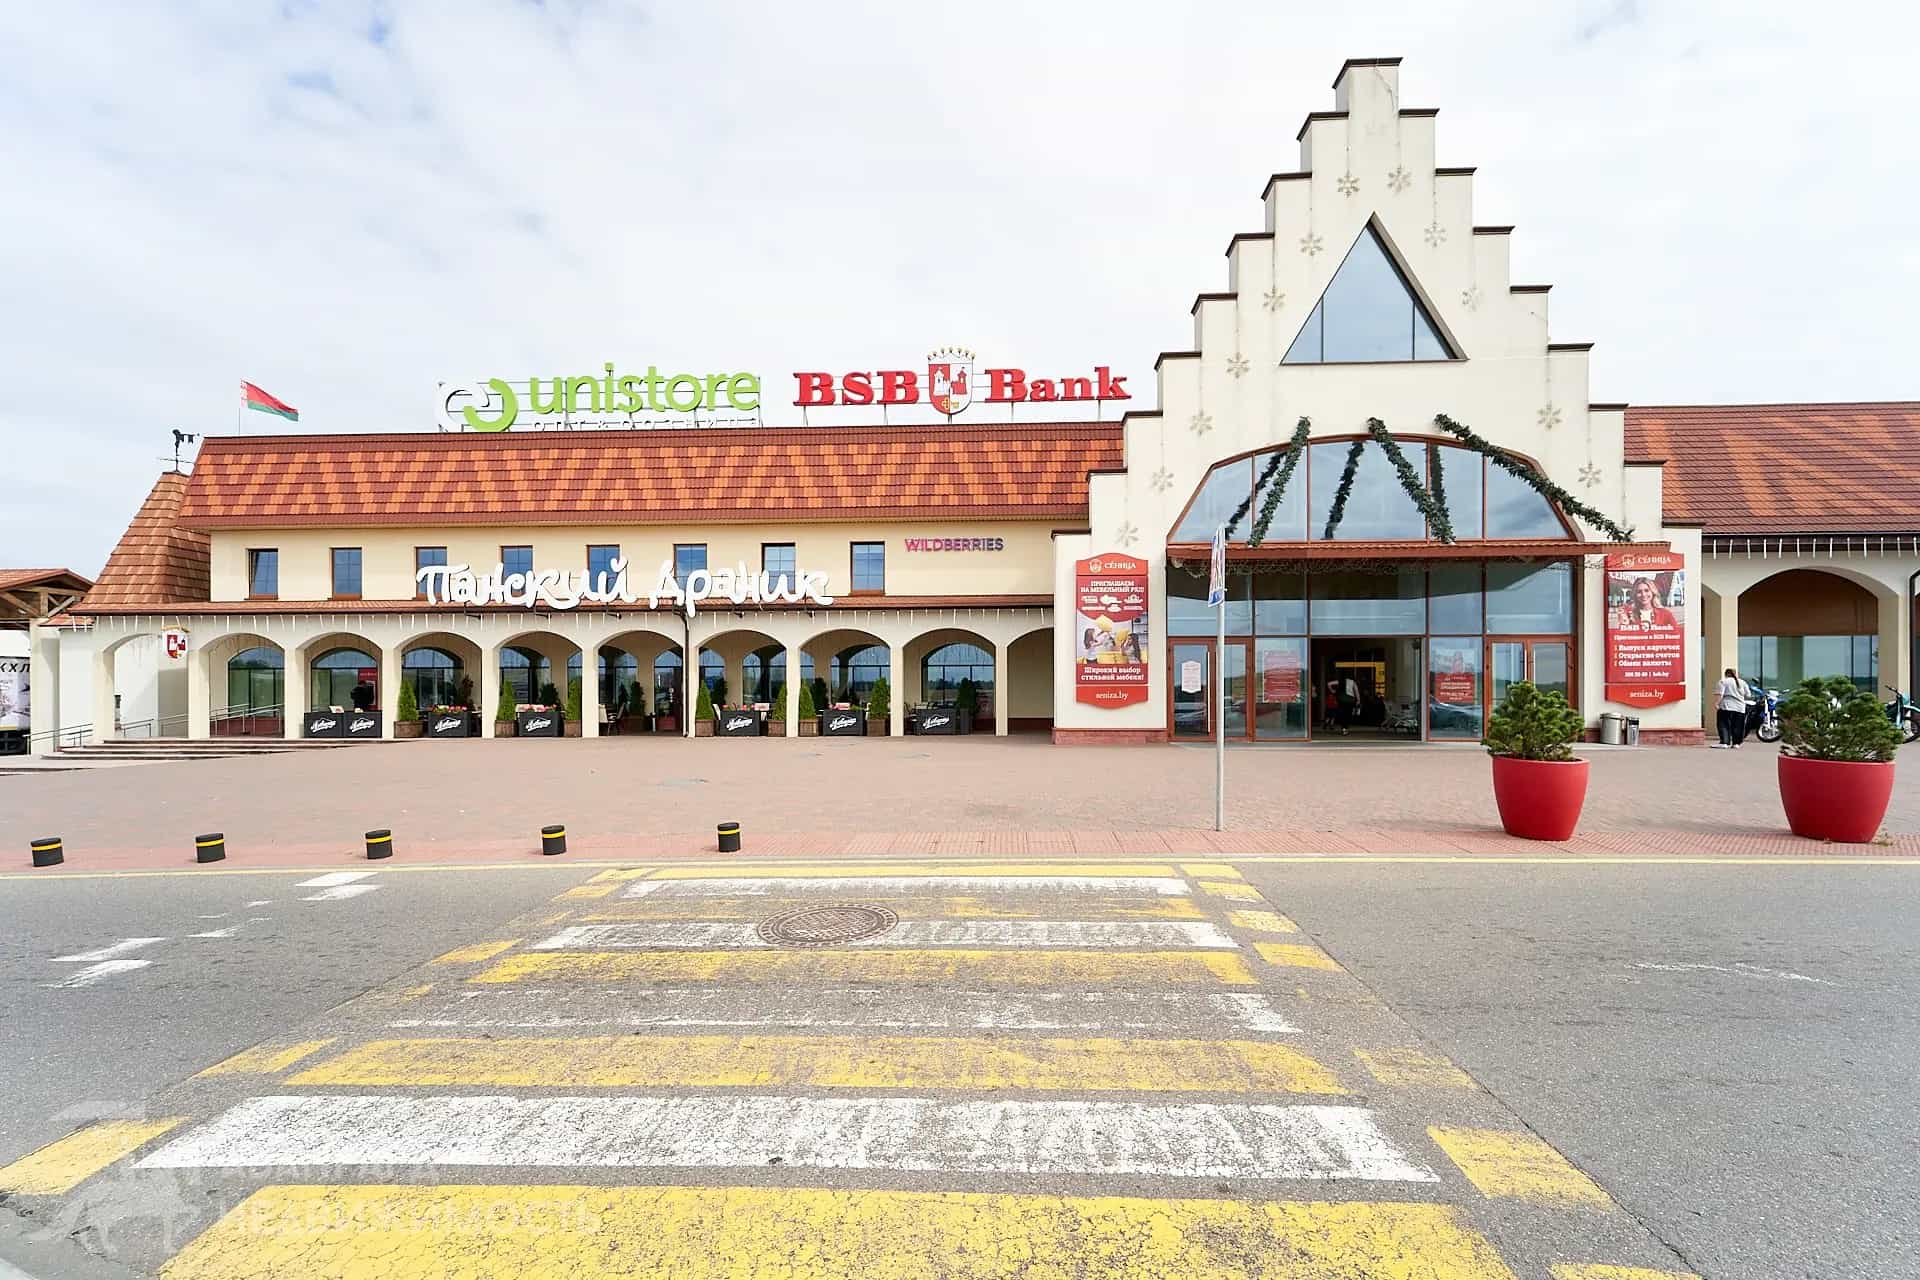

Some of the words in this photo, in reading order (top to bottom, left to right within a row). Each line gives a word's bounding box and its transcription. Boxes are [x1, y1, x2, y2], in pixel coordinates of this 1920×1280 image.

[529, 362, 760, 414] unistore
[793, 370, 919, 406] BSB
[984, 366, 1132, 403] Bank
[904, 537, 1004, 552] WILDBERRIES
[417, 556, 637, 610] Панский
[649, 560, 834, 618] Драник
[1080, 673, 1115, 681] стильной
[1116, 673, 1144, 681] мебели!
[1084, 666, 1117, 674] Широкий
[1118, 665, 1141, 674] выбор
